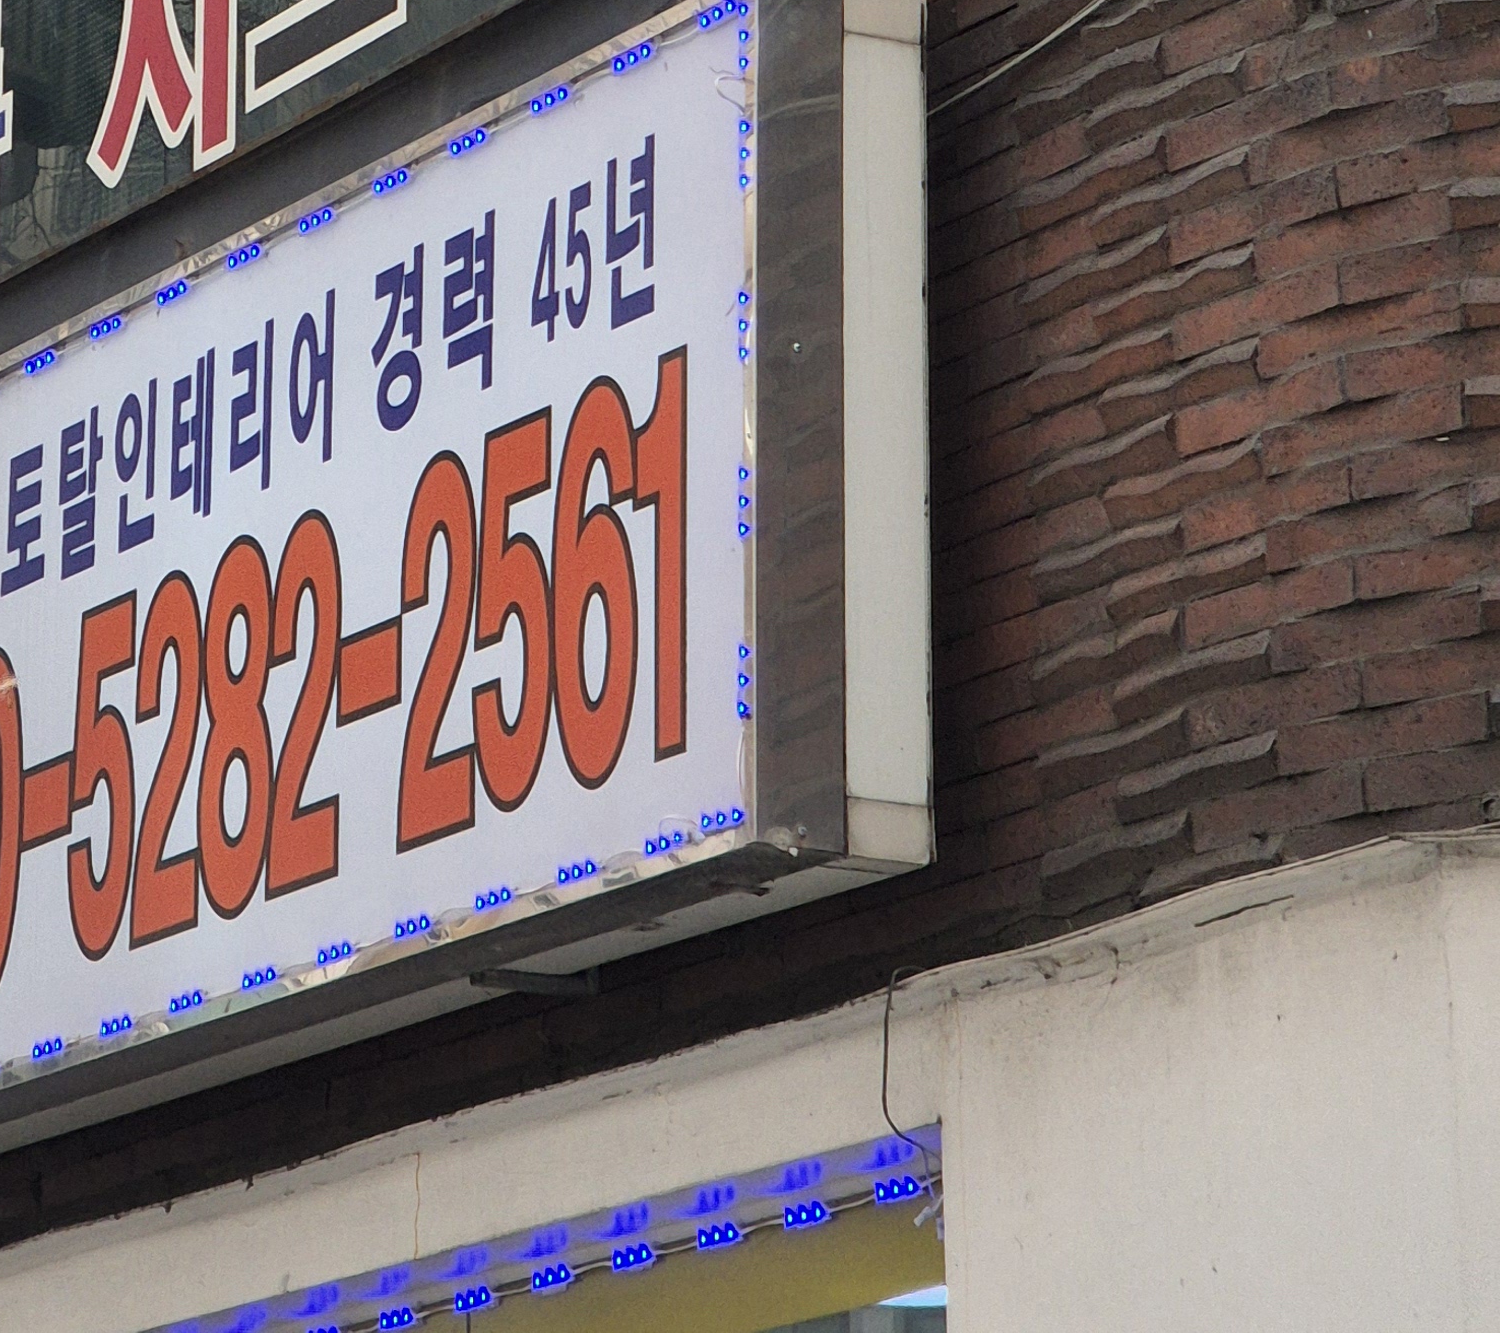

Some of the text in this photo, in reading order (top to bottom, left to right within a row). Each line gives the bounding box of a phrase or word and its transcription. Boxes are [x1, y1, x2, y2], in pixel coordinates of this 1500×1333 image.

[1, 134, 656, 596] 토탈인테리어 경력 45년
